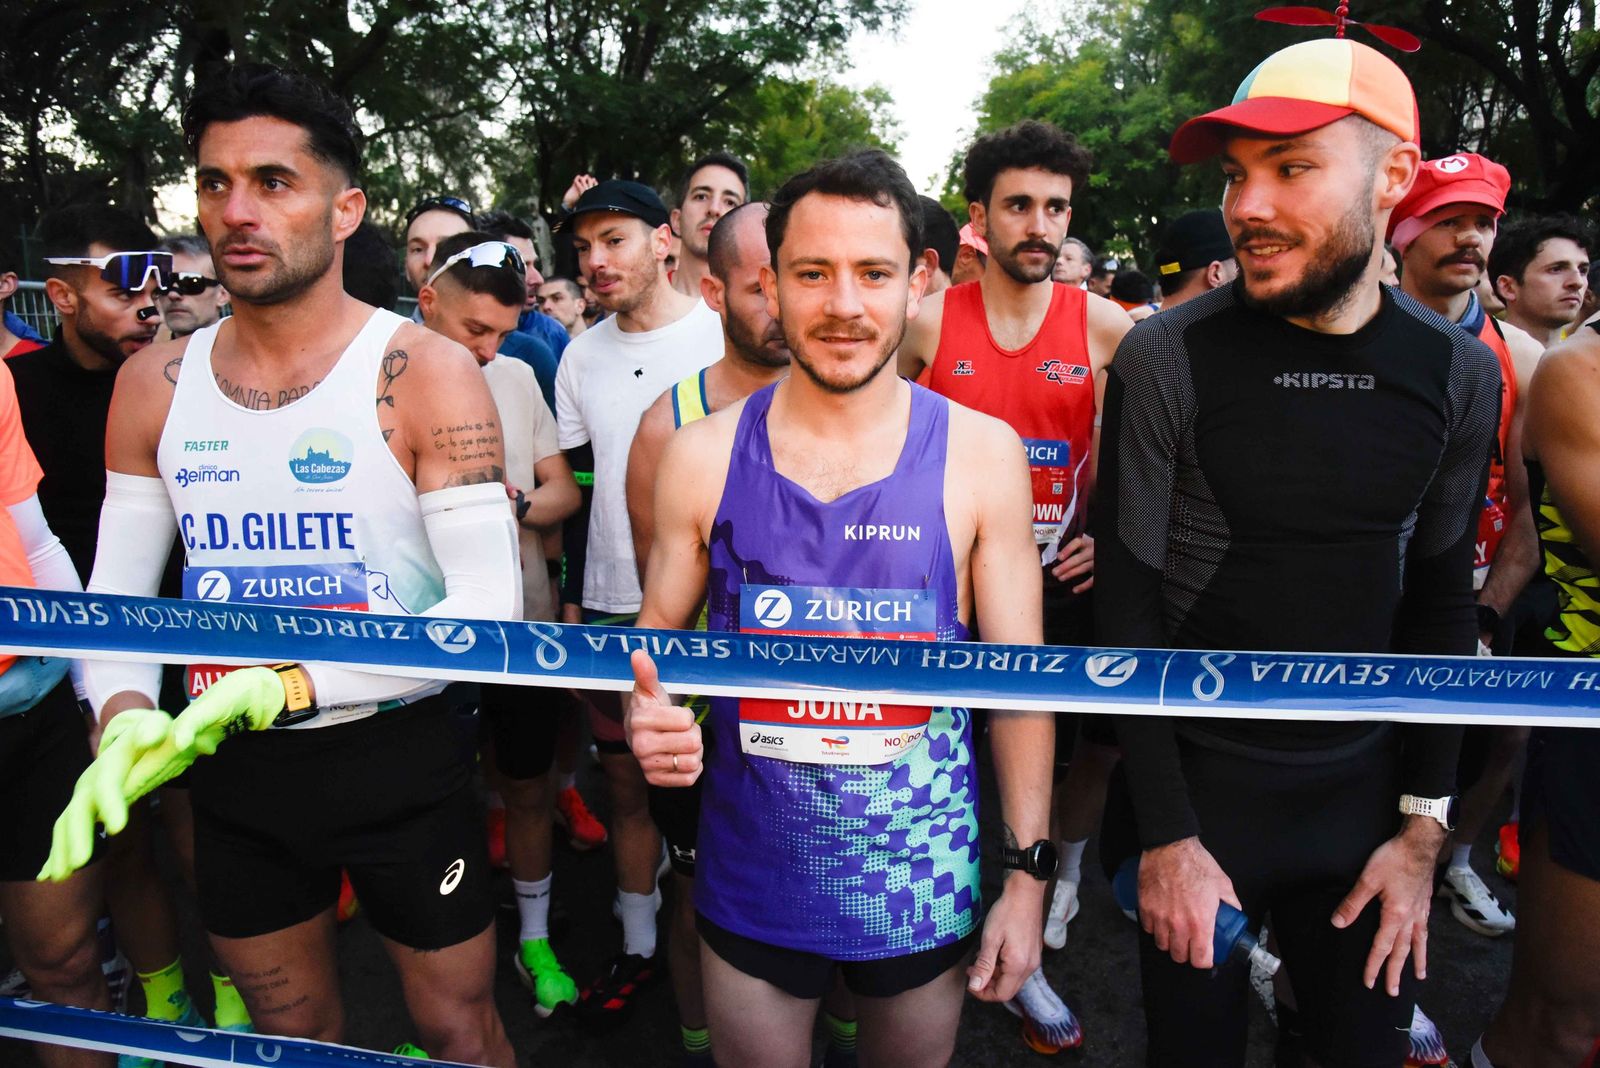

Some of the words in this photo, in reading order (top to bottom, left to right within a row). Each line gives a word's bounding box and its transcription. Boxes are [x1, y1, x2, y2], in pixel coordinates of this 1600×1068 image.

[184, 440, 230, 452] FASTER
[295, 463, 310, 473] Las
[311, 463, 346, 473] Cabezas
[1033, 503, 1063, 521] WN
[181, 512, 355, 550] C.D.GILETE
[844, 524, 921, 541] KIPRUN
[242, 576, 343, 599] ZURICH
[0, 597, 110, 626] SEVILL
[121, 605, 258, 633] MARATÓN
[804, 599, 912, 622] ZURICH
[274, 614, 410, 641] ZURICH
[582, 632, 731, 659] SEVILLA
[750, 640, 900, 667] MARATÓN
[920, 648, 1072, 673] ZURICH
[1251, 660, 1395, 686] SEVILLA
[1406, 666, 1556, 692] MARATÓN
[787, 701, 883, 721] JONA
